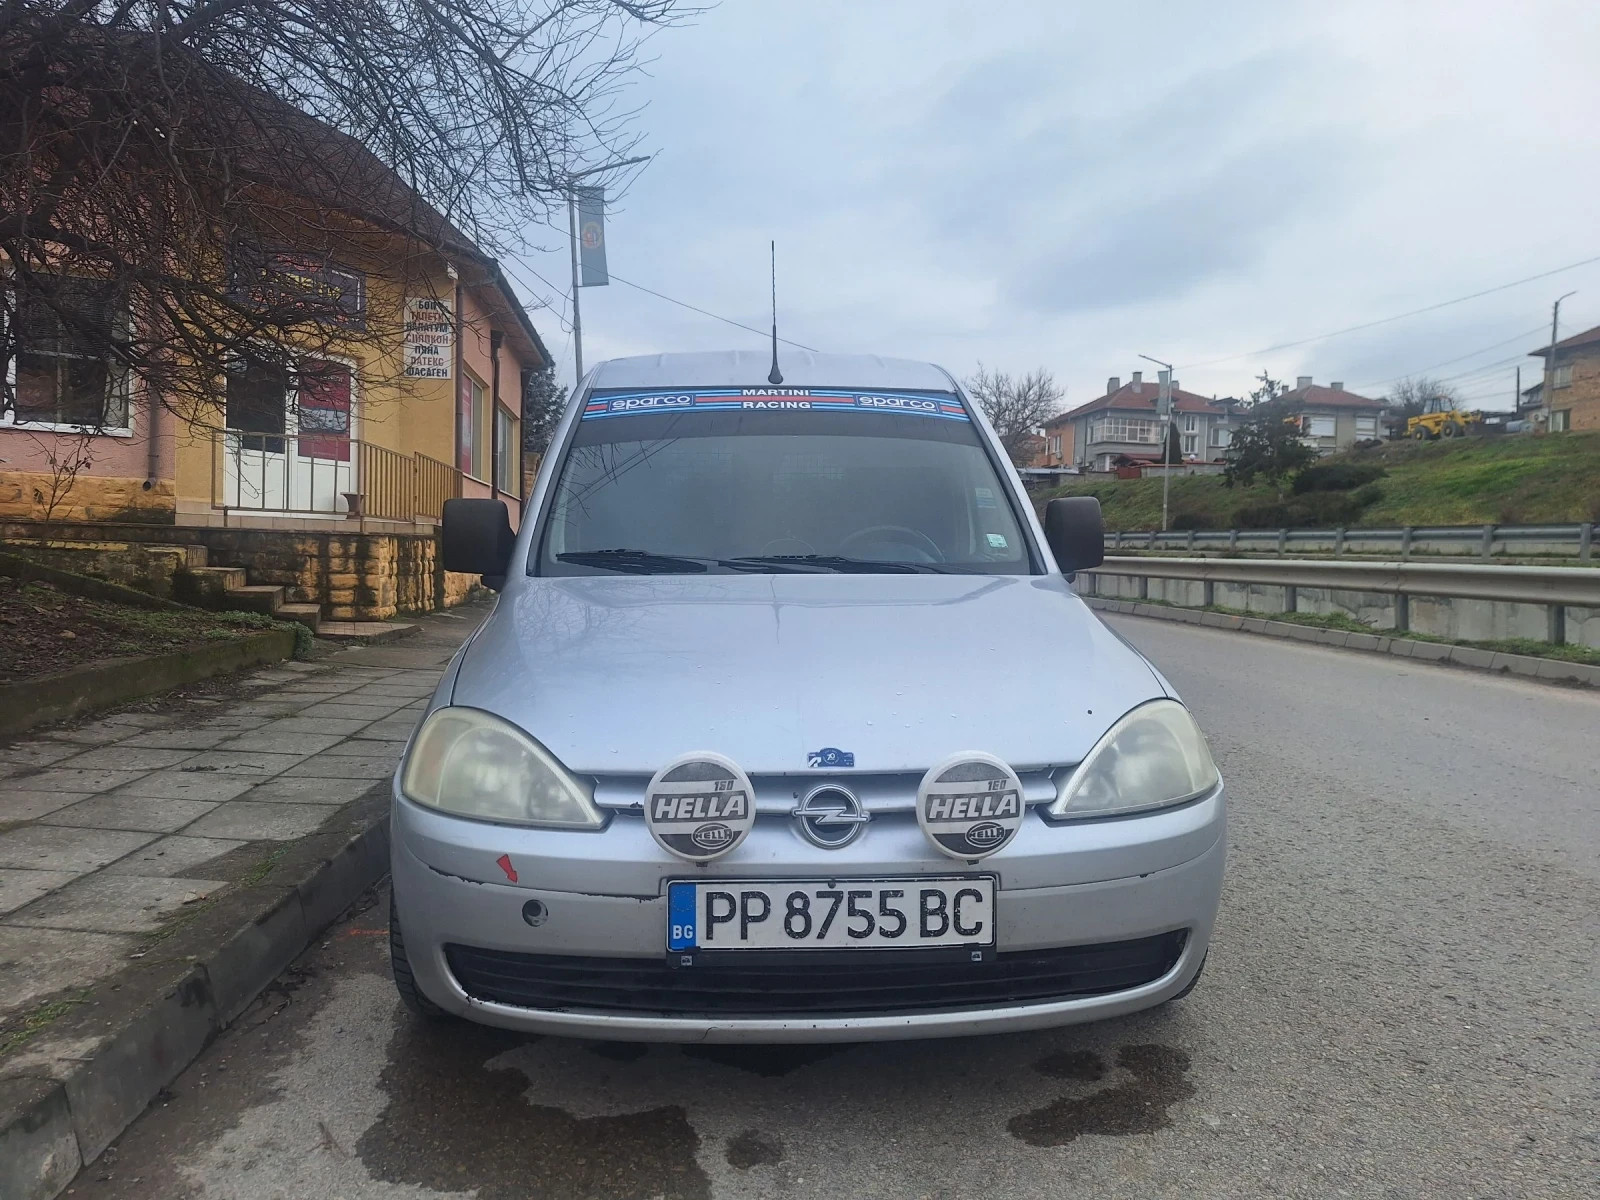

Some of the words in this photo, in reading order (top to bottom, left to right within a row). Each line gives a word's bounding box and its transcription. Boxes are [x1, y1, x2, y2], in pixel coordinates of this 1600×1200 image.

[414, 345, 439, 355] ПЯНА
[410, 356, 444, 366] ЛАТЕКС
[610, 395, 692, 410] sparco
[857, 396, 937, 410] sparco
[654, 795, 745, 819] HELLA
[928, 794, 1017, 819] HELLA
[695, 828, 733, 840] HELLA
[969, 826, 1005, 839] HELLA
[705, 890, 771, 941] PP
[784, 890, 907, 940] 8755
[919, 888, 983, 938] BC
[672, 925, 693, 939] BG
